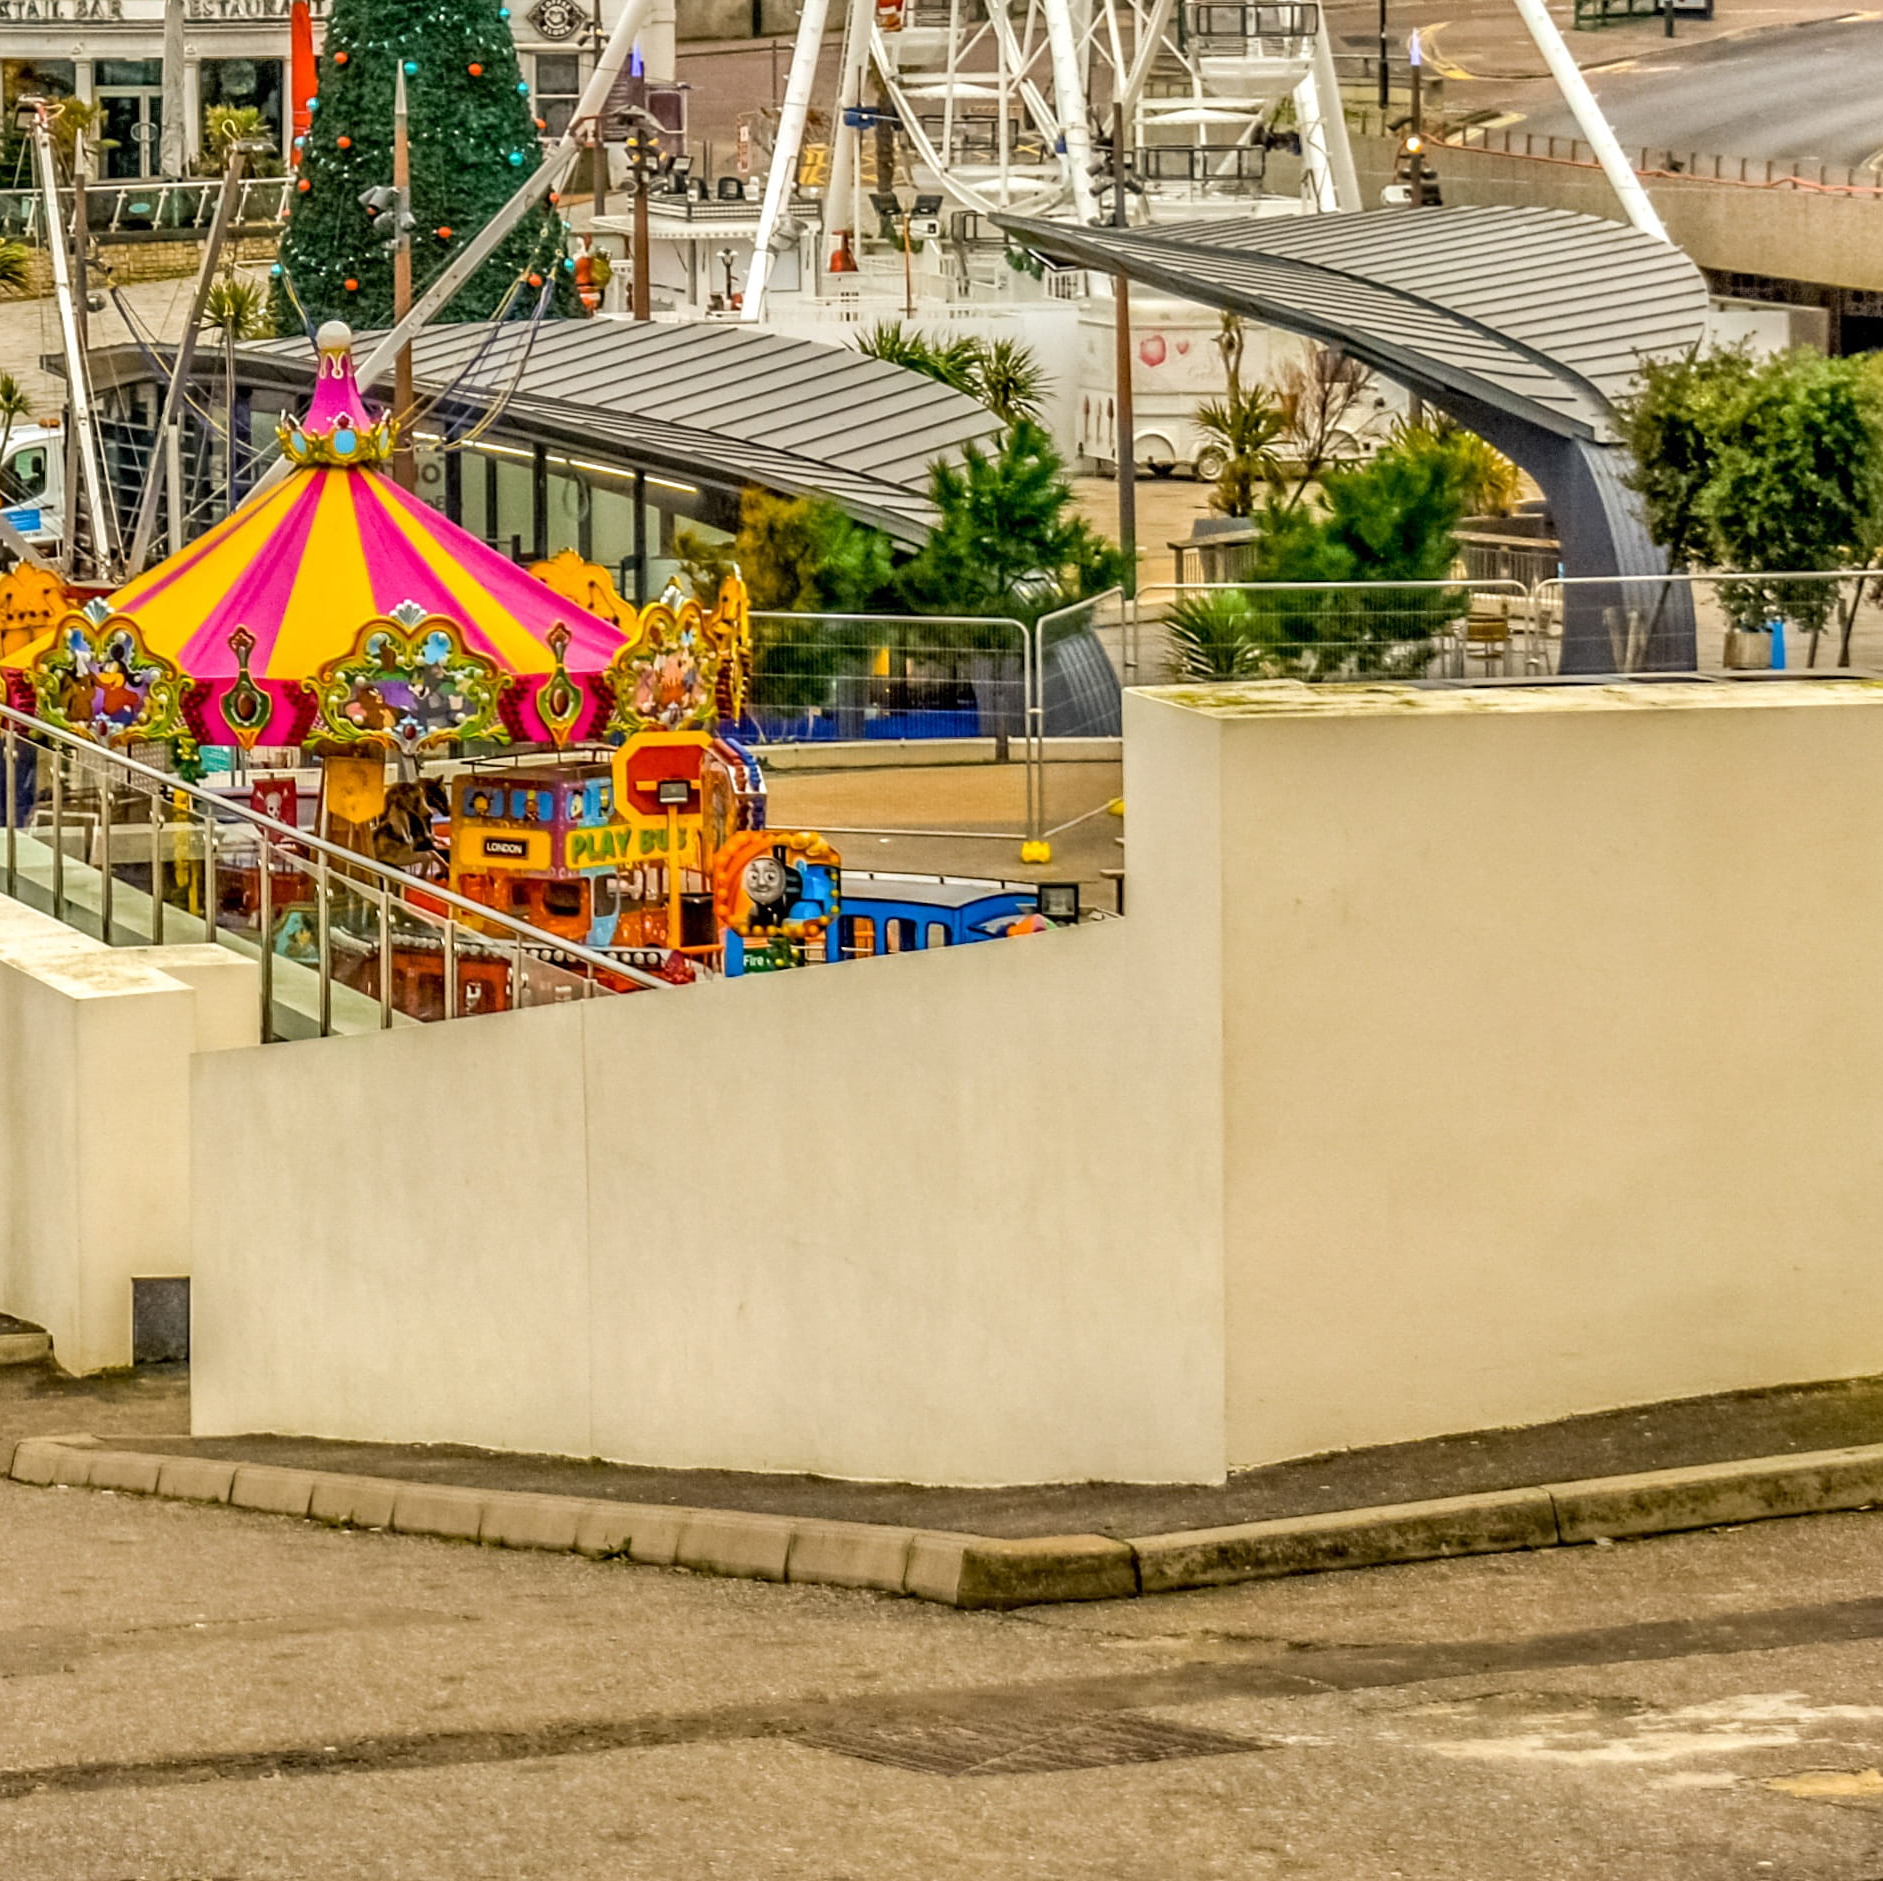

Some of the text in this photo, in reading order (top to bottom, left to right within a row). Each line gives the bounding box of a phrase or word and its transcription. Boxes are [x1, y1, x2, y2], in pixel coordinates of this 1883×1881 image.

[74, 0, 124, 19] BAR
[486, 842, 523, 854] LONDON
[570, 827, 631, 864] PLAY
